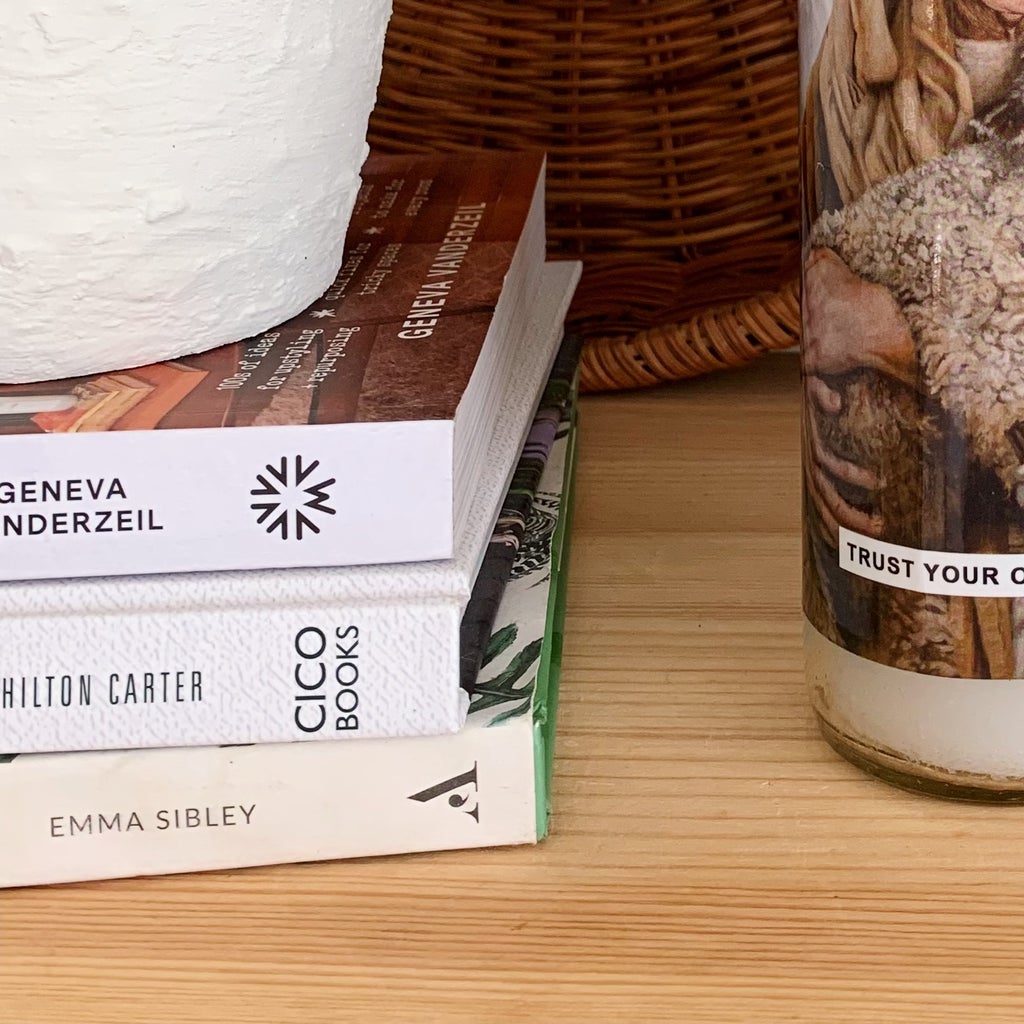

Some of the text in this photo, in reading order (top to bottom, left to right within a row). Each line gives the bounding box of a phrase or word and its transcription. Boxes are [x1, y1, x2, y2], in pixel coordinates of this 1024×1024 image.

[325, 277, 350, 301] quick
[357, 269, 392, 295] tricky
[397, 202, 486, 339] GENEVA VANDERZEIL
[216, 332, 281, 391] 100s of ideas
[257, 328, 324, 391] for upstyling
[307, 326, 361, 383] repurposing
[0, 478, 127, 504] GENEVA
[847, 542, 914, 578] TRUST
[923, 563, 999, 585] YOUR
[2, 671, 203, 709] HILTON CARTER
[294, 626, 327, 733] CICO
[335, 625, 359, 731] BOOKS
[50, 804, 256, 838] EMMA SIBLEY
